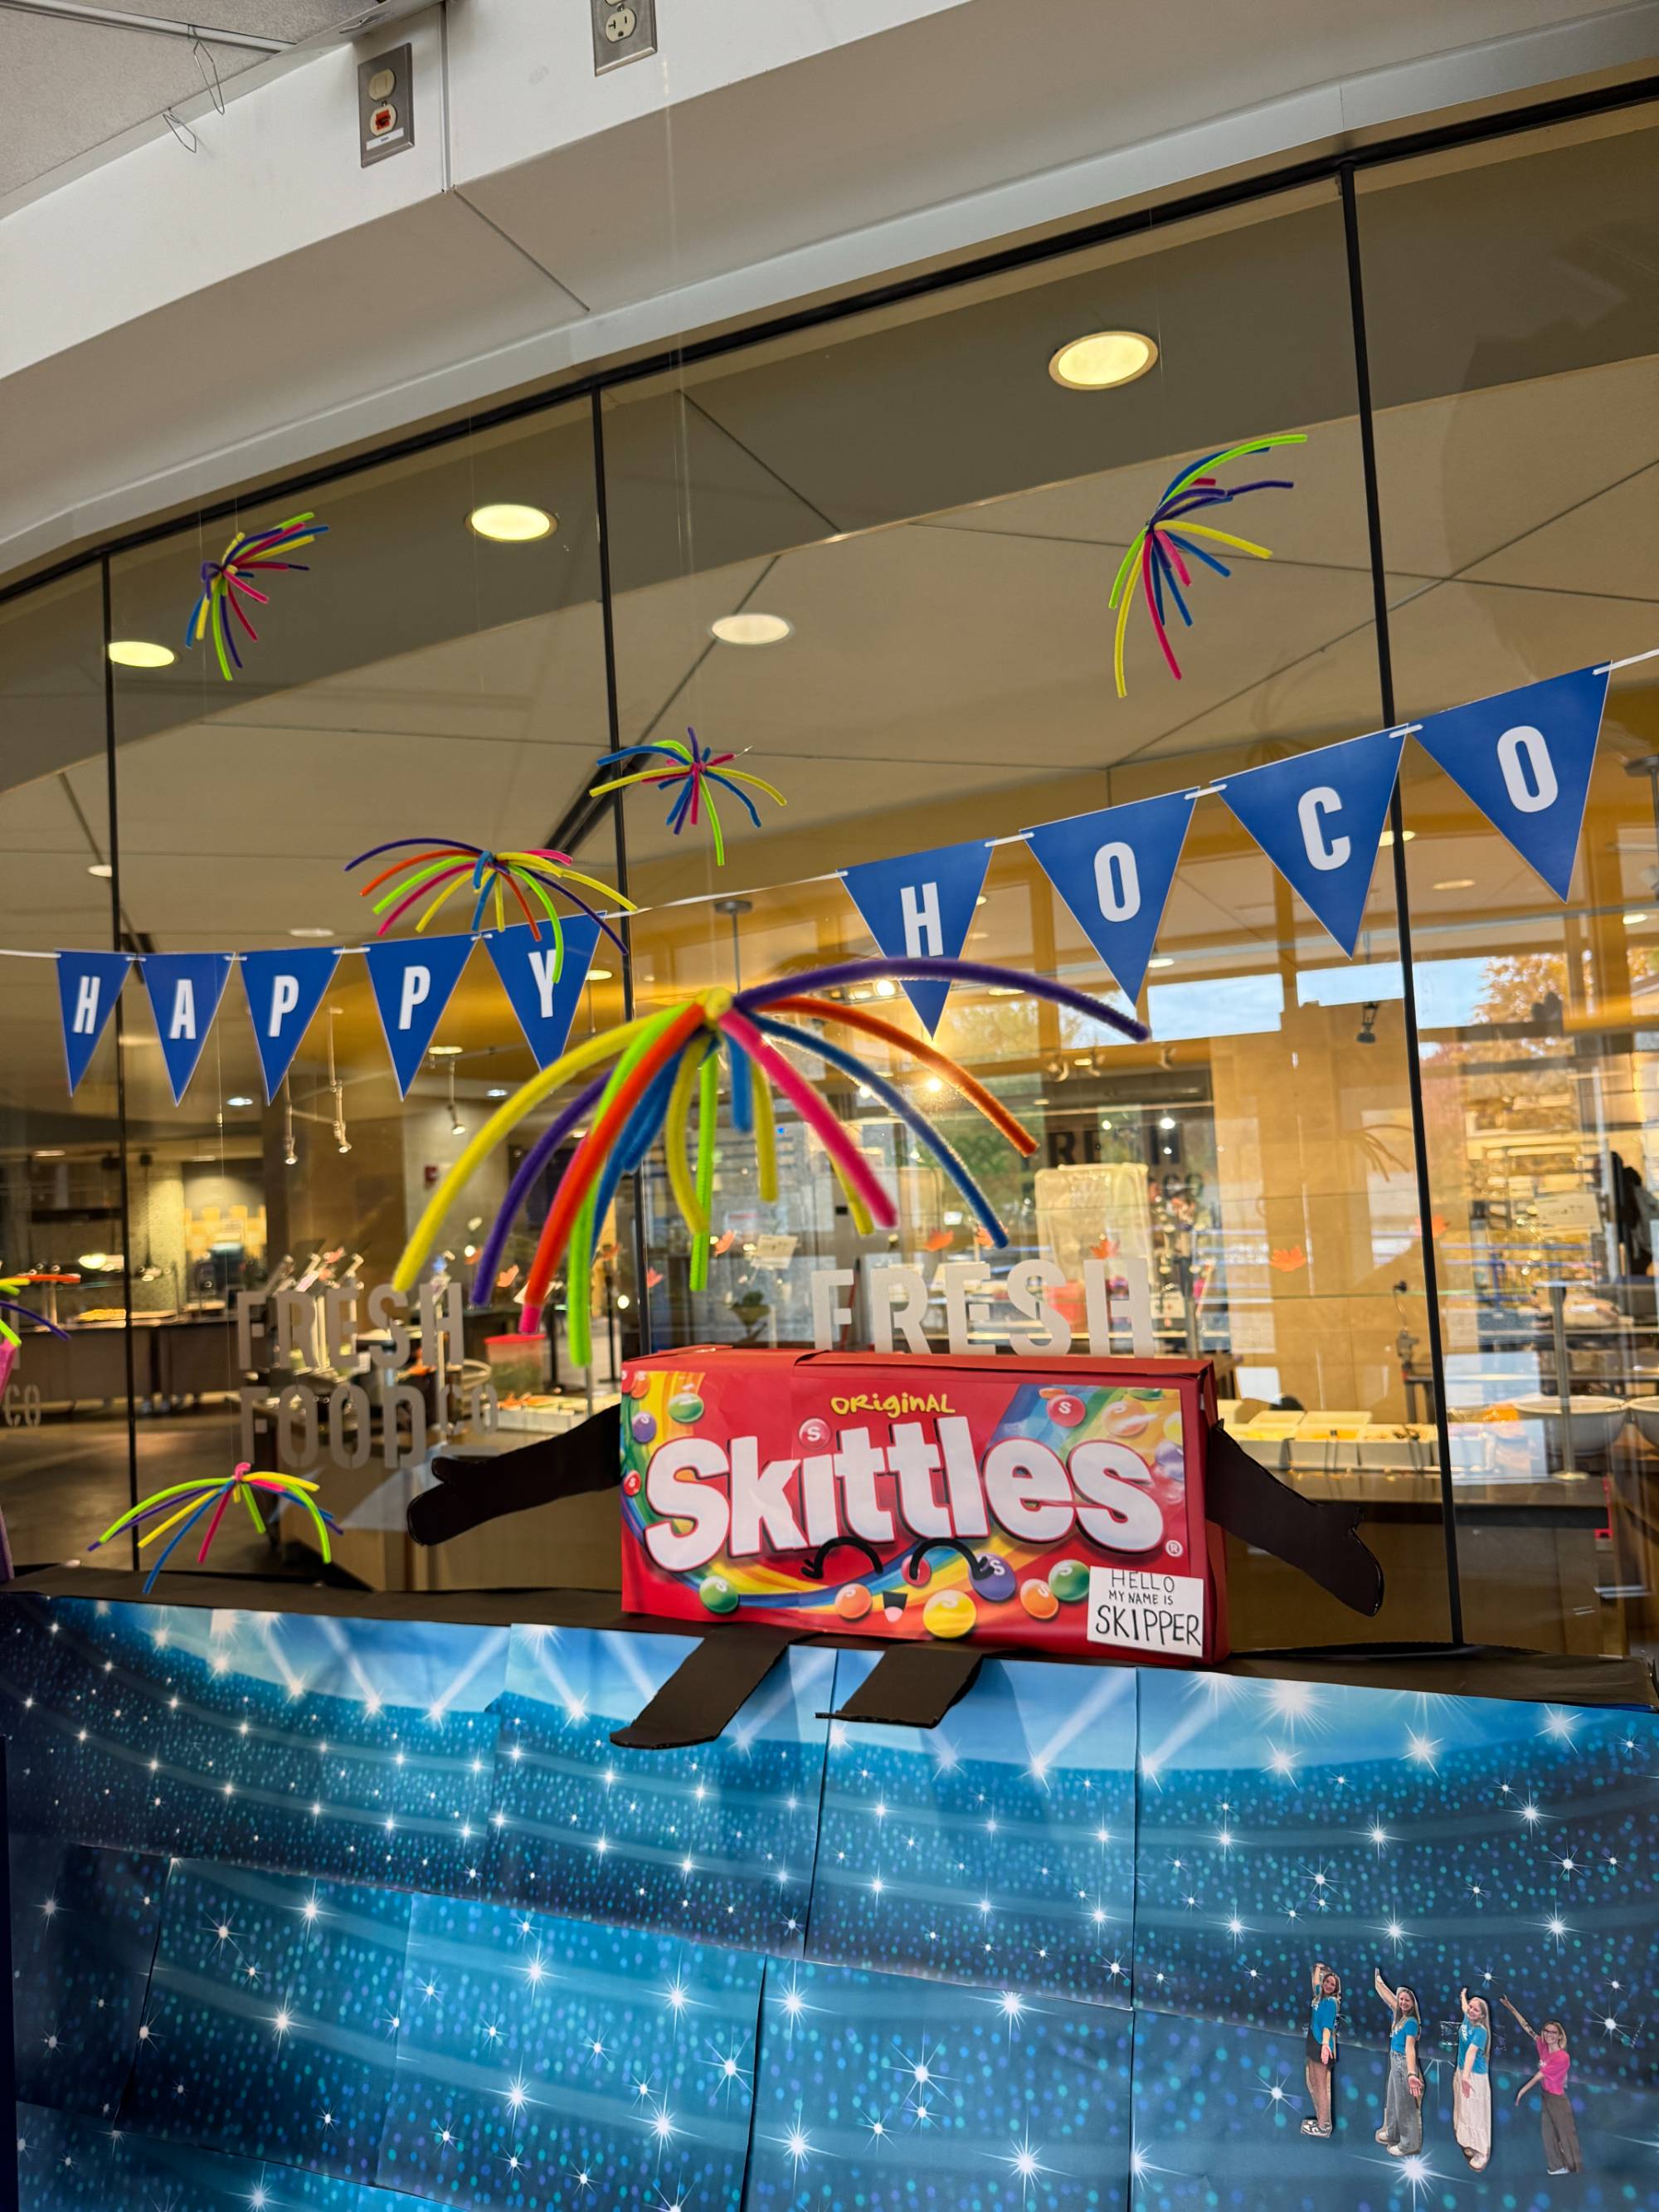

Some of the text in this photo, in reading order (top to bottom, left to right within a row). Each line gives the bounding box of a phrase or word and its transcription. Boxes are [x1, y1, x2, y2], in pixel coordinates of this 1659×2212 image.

[73, 725, 1559, 1040] HAPPY HOCO
[237, 1283, 465, 1370] FRESH
[811, 1258, 1155, 1359] FRESH
[5, 1384, 41, 1427] CO
[240, 1384, 426, 1470] FOOD
[806, 1426, 822, 1442] S
[645, 1416, 1164, 1571] Skittles
[1108, 1590, 1174, 1605] MY NAME IS
[1111, 1568, 1175, 1593] HELLO
[1095, 1604, 1202, 1647] SKIPPER
